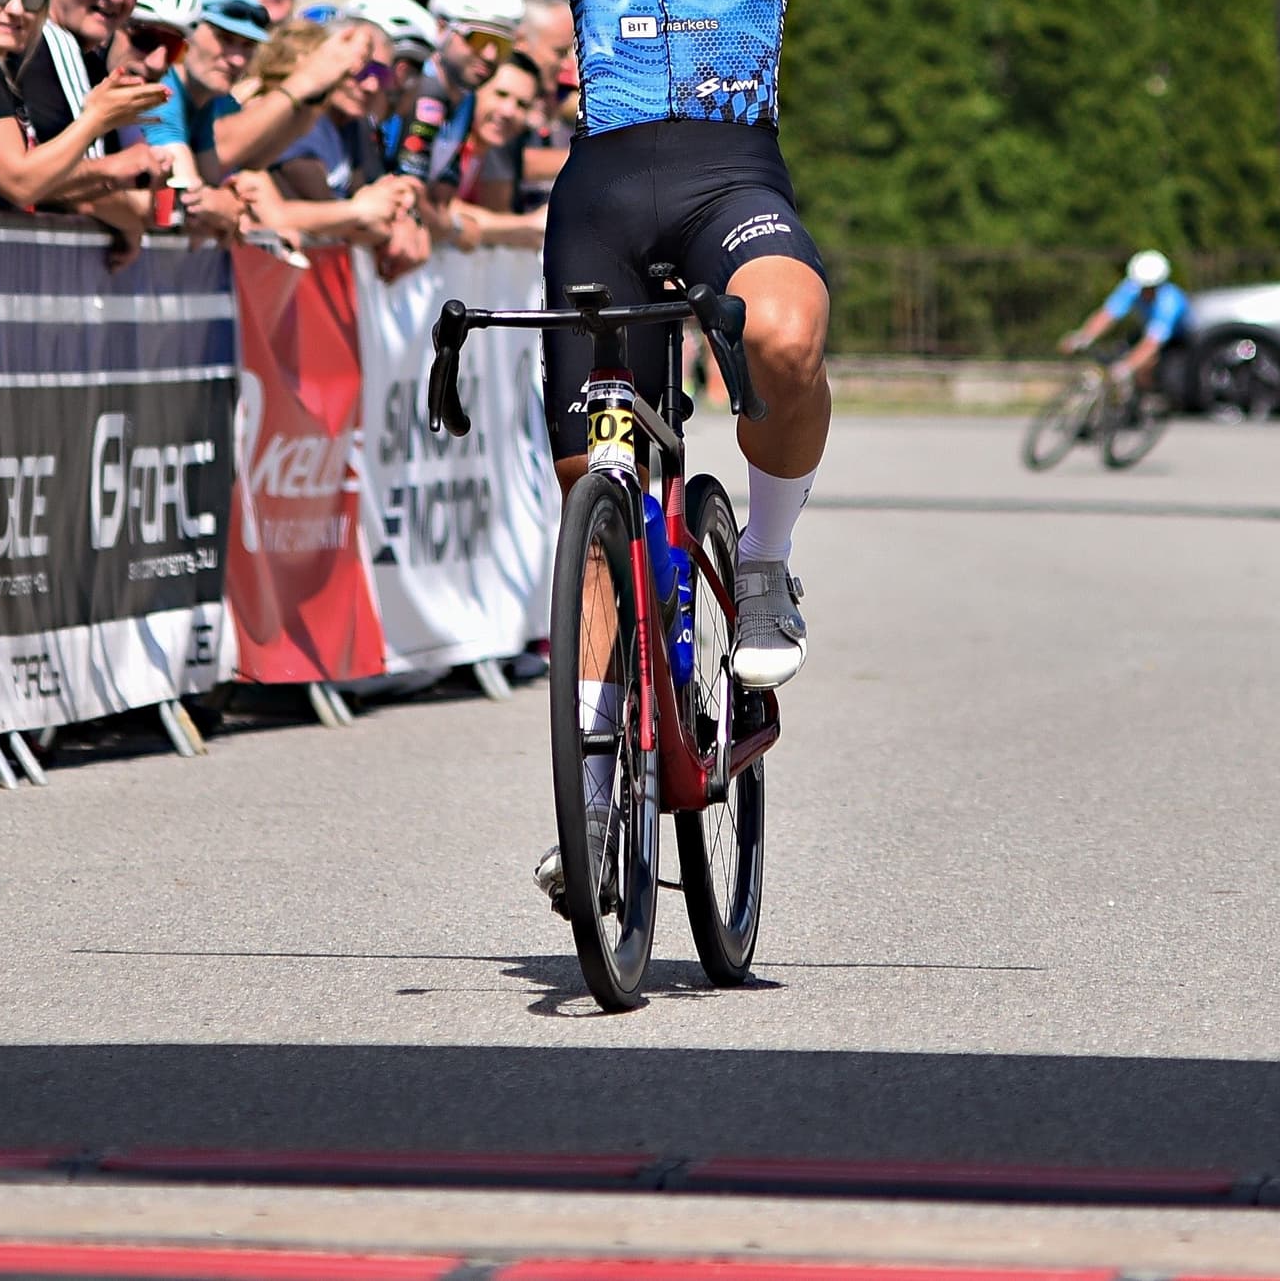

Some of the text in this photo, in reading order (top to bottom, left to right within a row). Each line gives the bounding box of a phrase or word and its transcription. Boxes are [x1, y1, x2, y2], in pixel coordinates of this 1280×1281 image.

[627, 17, 719, 34] BIT markets
[721, 79, 759, 93] LAWI
